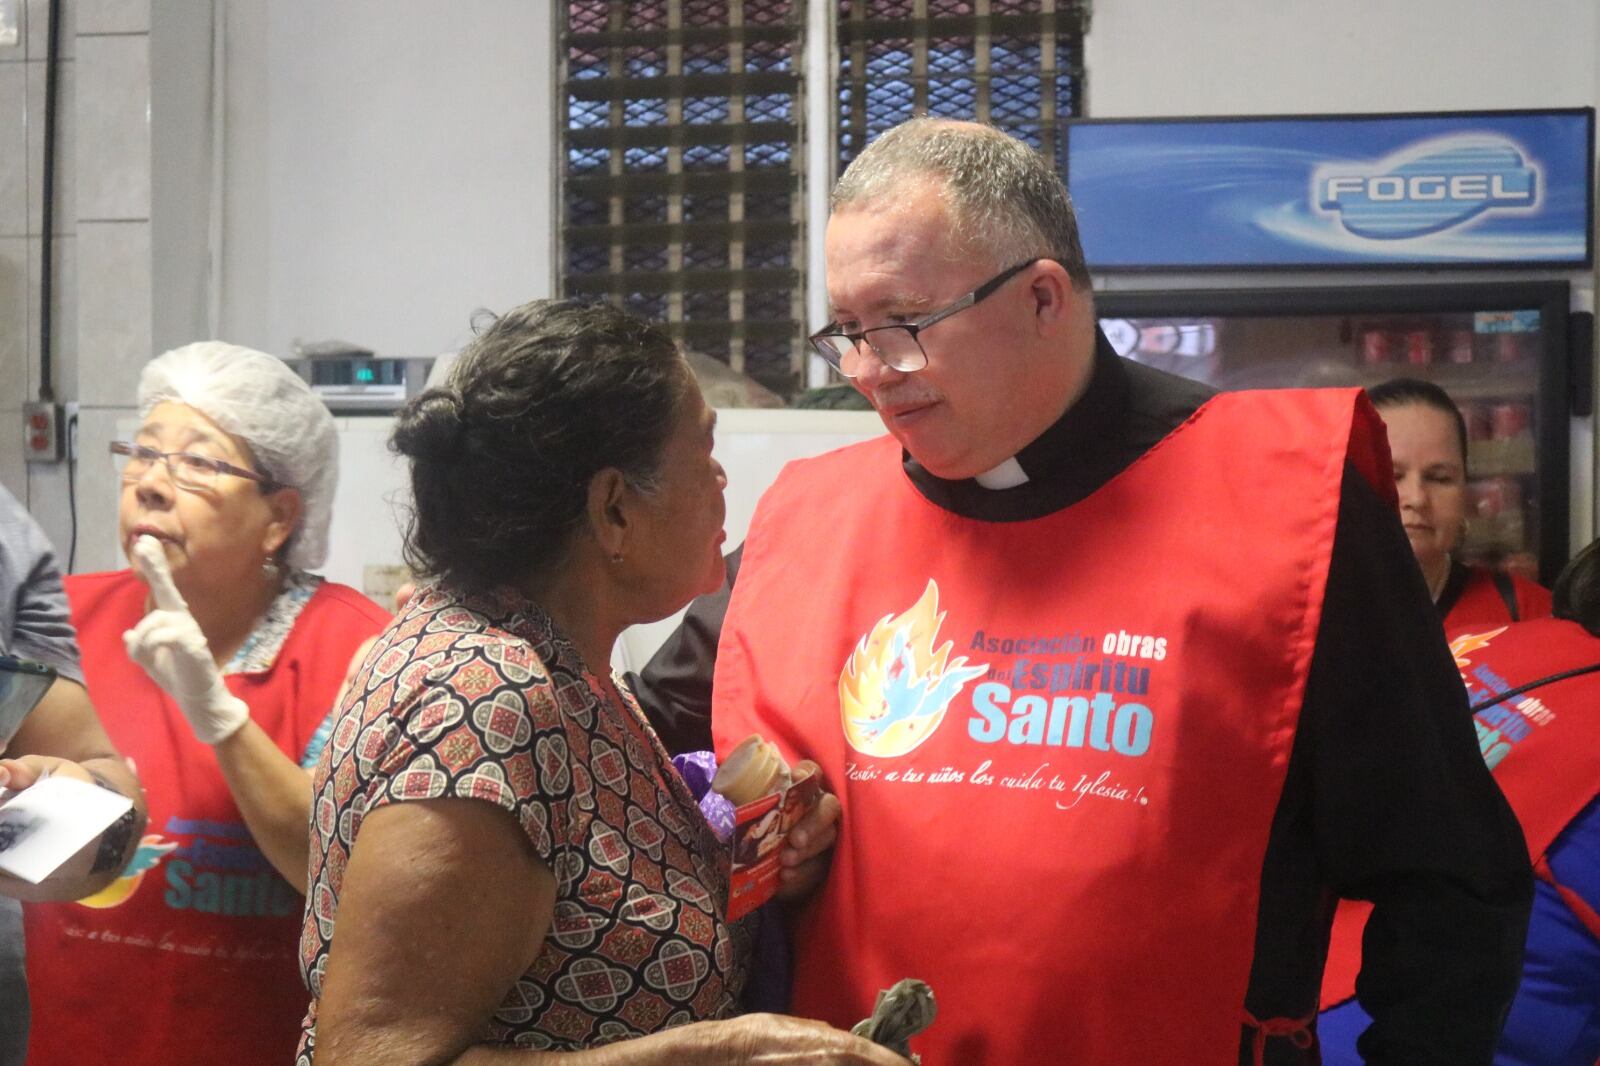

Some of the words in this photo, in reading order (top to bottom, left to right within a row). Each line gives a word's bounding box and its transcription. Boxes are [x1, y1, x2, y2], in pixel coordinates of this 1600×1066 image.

[1327, 174, 1529, 202] FOGEL
[969, 629, 1096, 656] Asociación
[1102, 629, 1168, 662] obras
[1012, 656, 1151, 696] Espíritu
[968, 681, 1154, 758] Santo
[885, 769, 900, 782] a
[902, 767, 925, 784] tus
[927, 766, 966, 784] niños
[969, 759, 995, 786] los
[1000, 762, 1050, 791] cuida
[1049, 774, 1067, 792] tu
